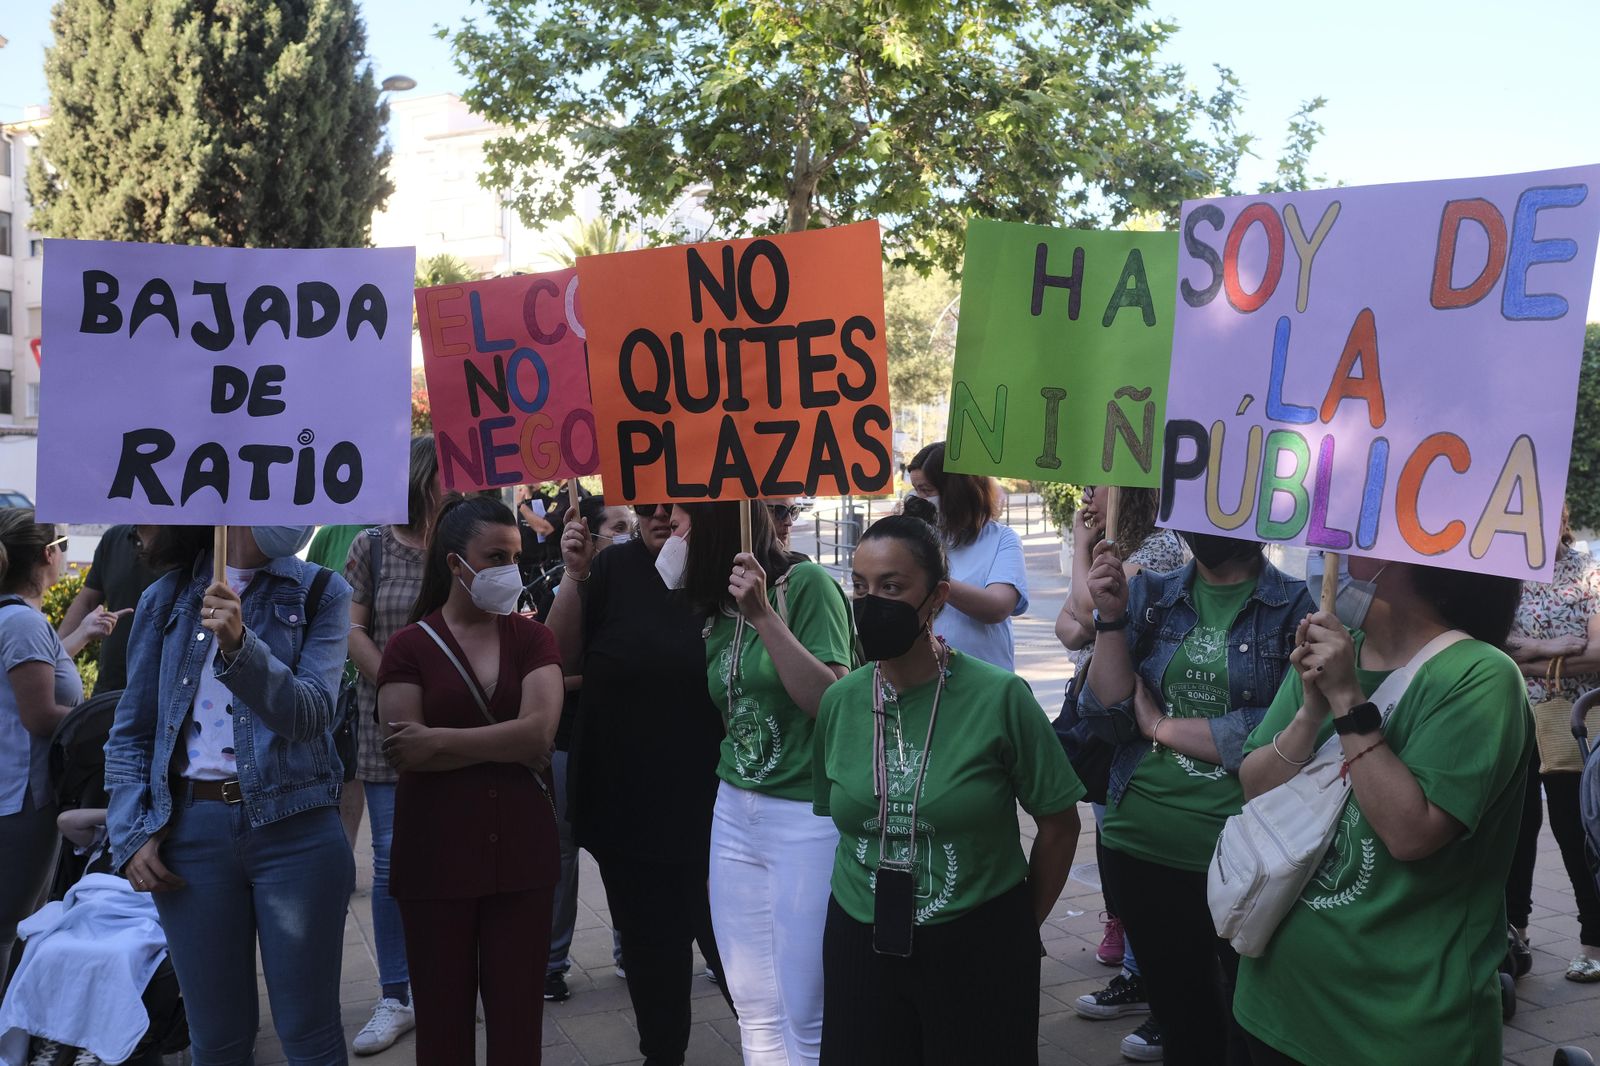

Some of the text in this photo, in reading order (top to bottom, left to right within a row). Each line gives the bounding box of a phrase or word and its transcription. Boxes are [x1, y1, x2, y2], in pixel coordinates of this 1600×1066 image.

[687, 239, 789, 324] NO
[1031, 243, 1156, 327] HA
[1180, 184, 1588, 321] SOY DE
[79, 269, 388, 351] BAJADA
[425, 287, 516, 358] EL
[211, 364, 286, 417] DE
[464, 347, 549, 418] NO
[619, 315, 877, 414] QUITES
[1266, 308, 1386, 429] LA
[617, 404, 891, 501] PLAZAS
[950, 381, 1156, 474] NIÑ
[1159, 394, 1546, 570] PÚBLICA
[1186, 669, 1216, 682] CEIP
[1187, 691, 1216, 702] RONDA
